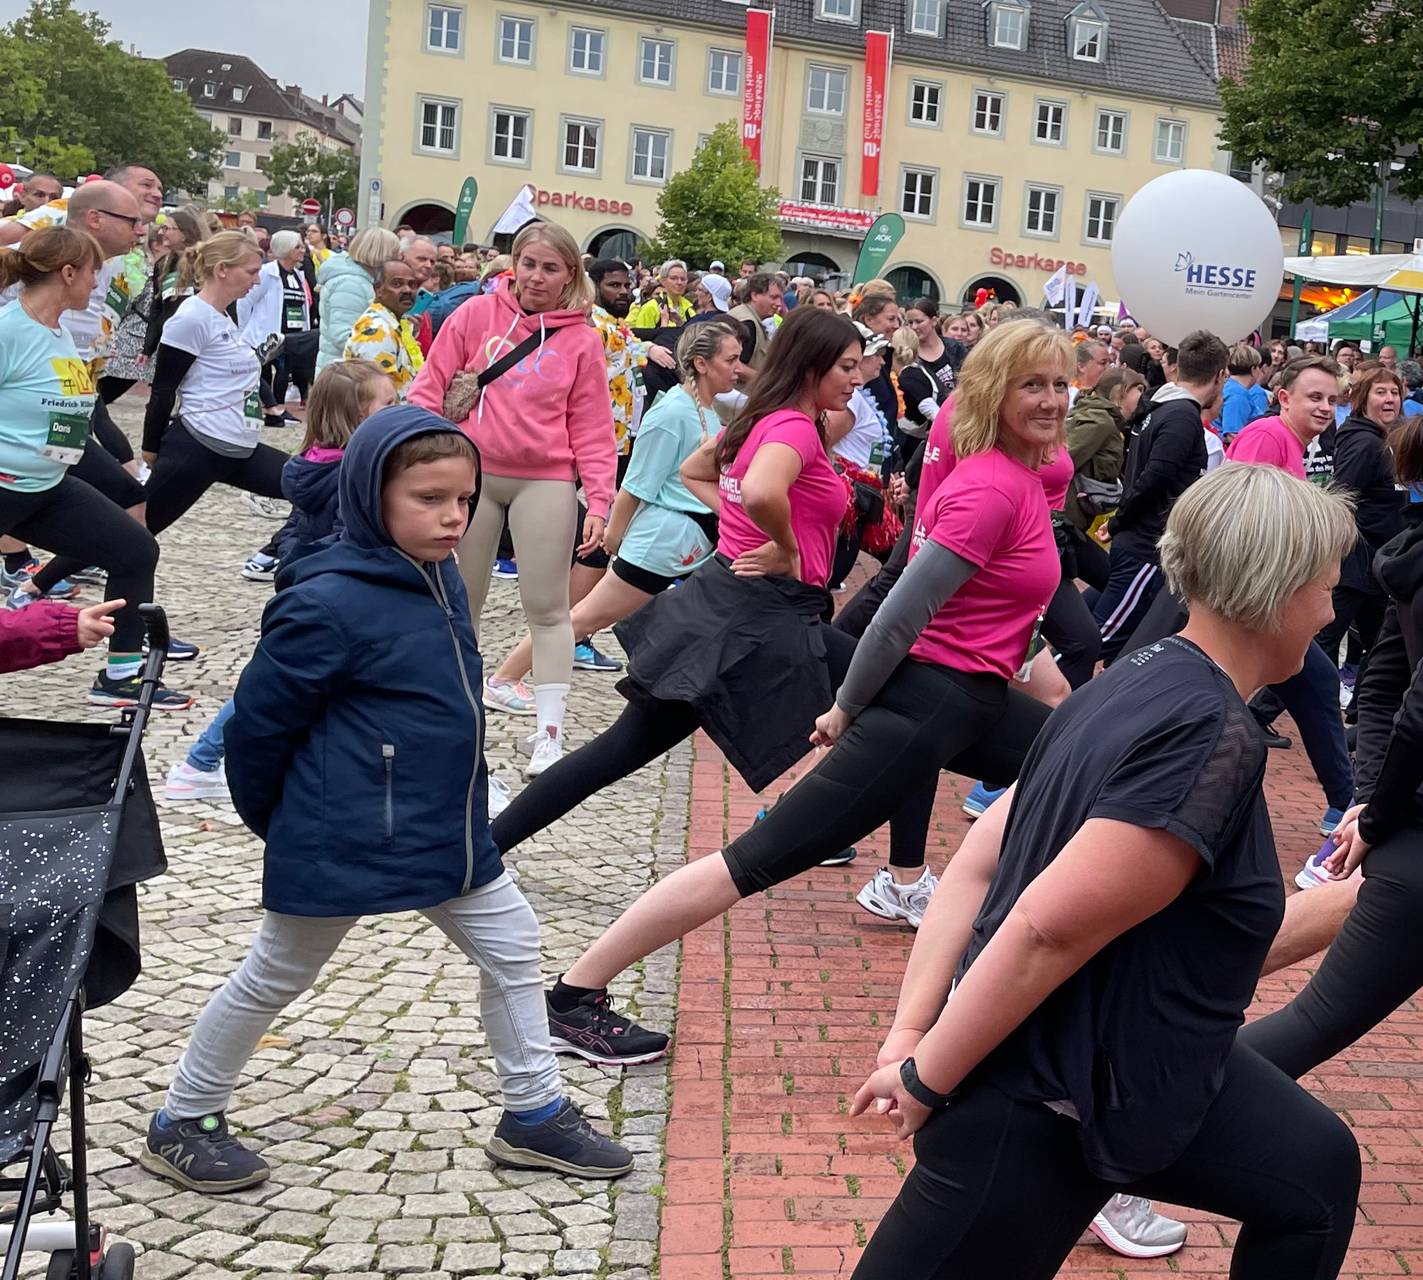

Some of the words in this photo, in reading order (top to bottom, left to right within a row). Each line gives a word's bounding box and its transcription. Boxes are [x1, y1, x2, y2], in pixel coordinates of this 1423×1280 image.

[874, 234, 892, 242] AOK
[1186, 263, 1256, 288] HESSE
[1185, 287, 1206, 296] Mein
[41, 398, 79, 407] Friedrich
[53, 422, 71, 433] Doris
